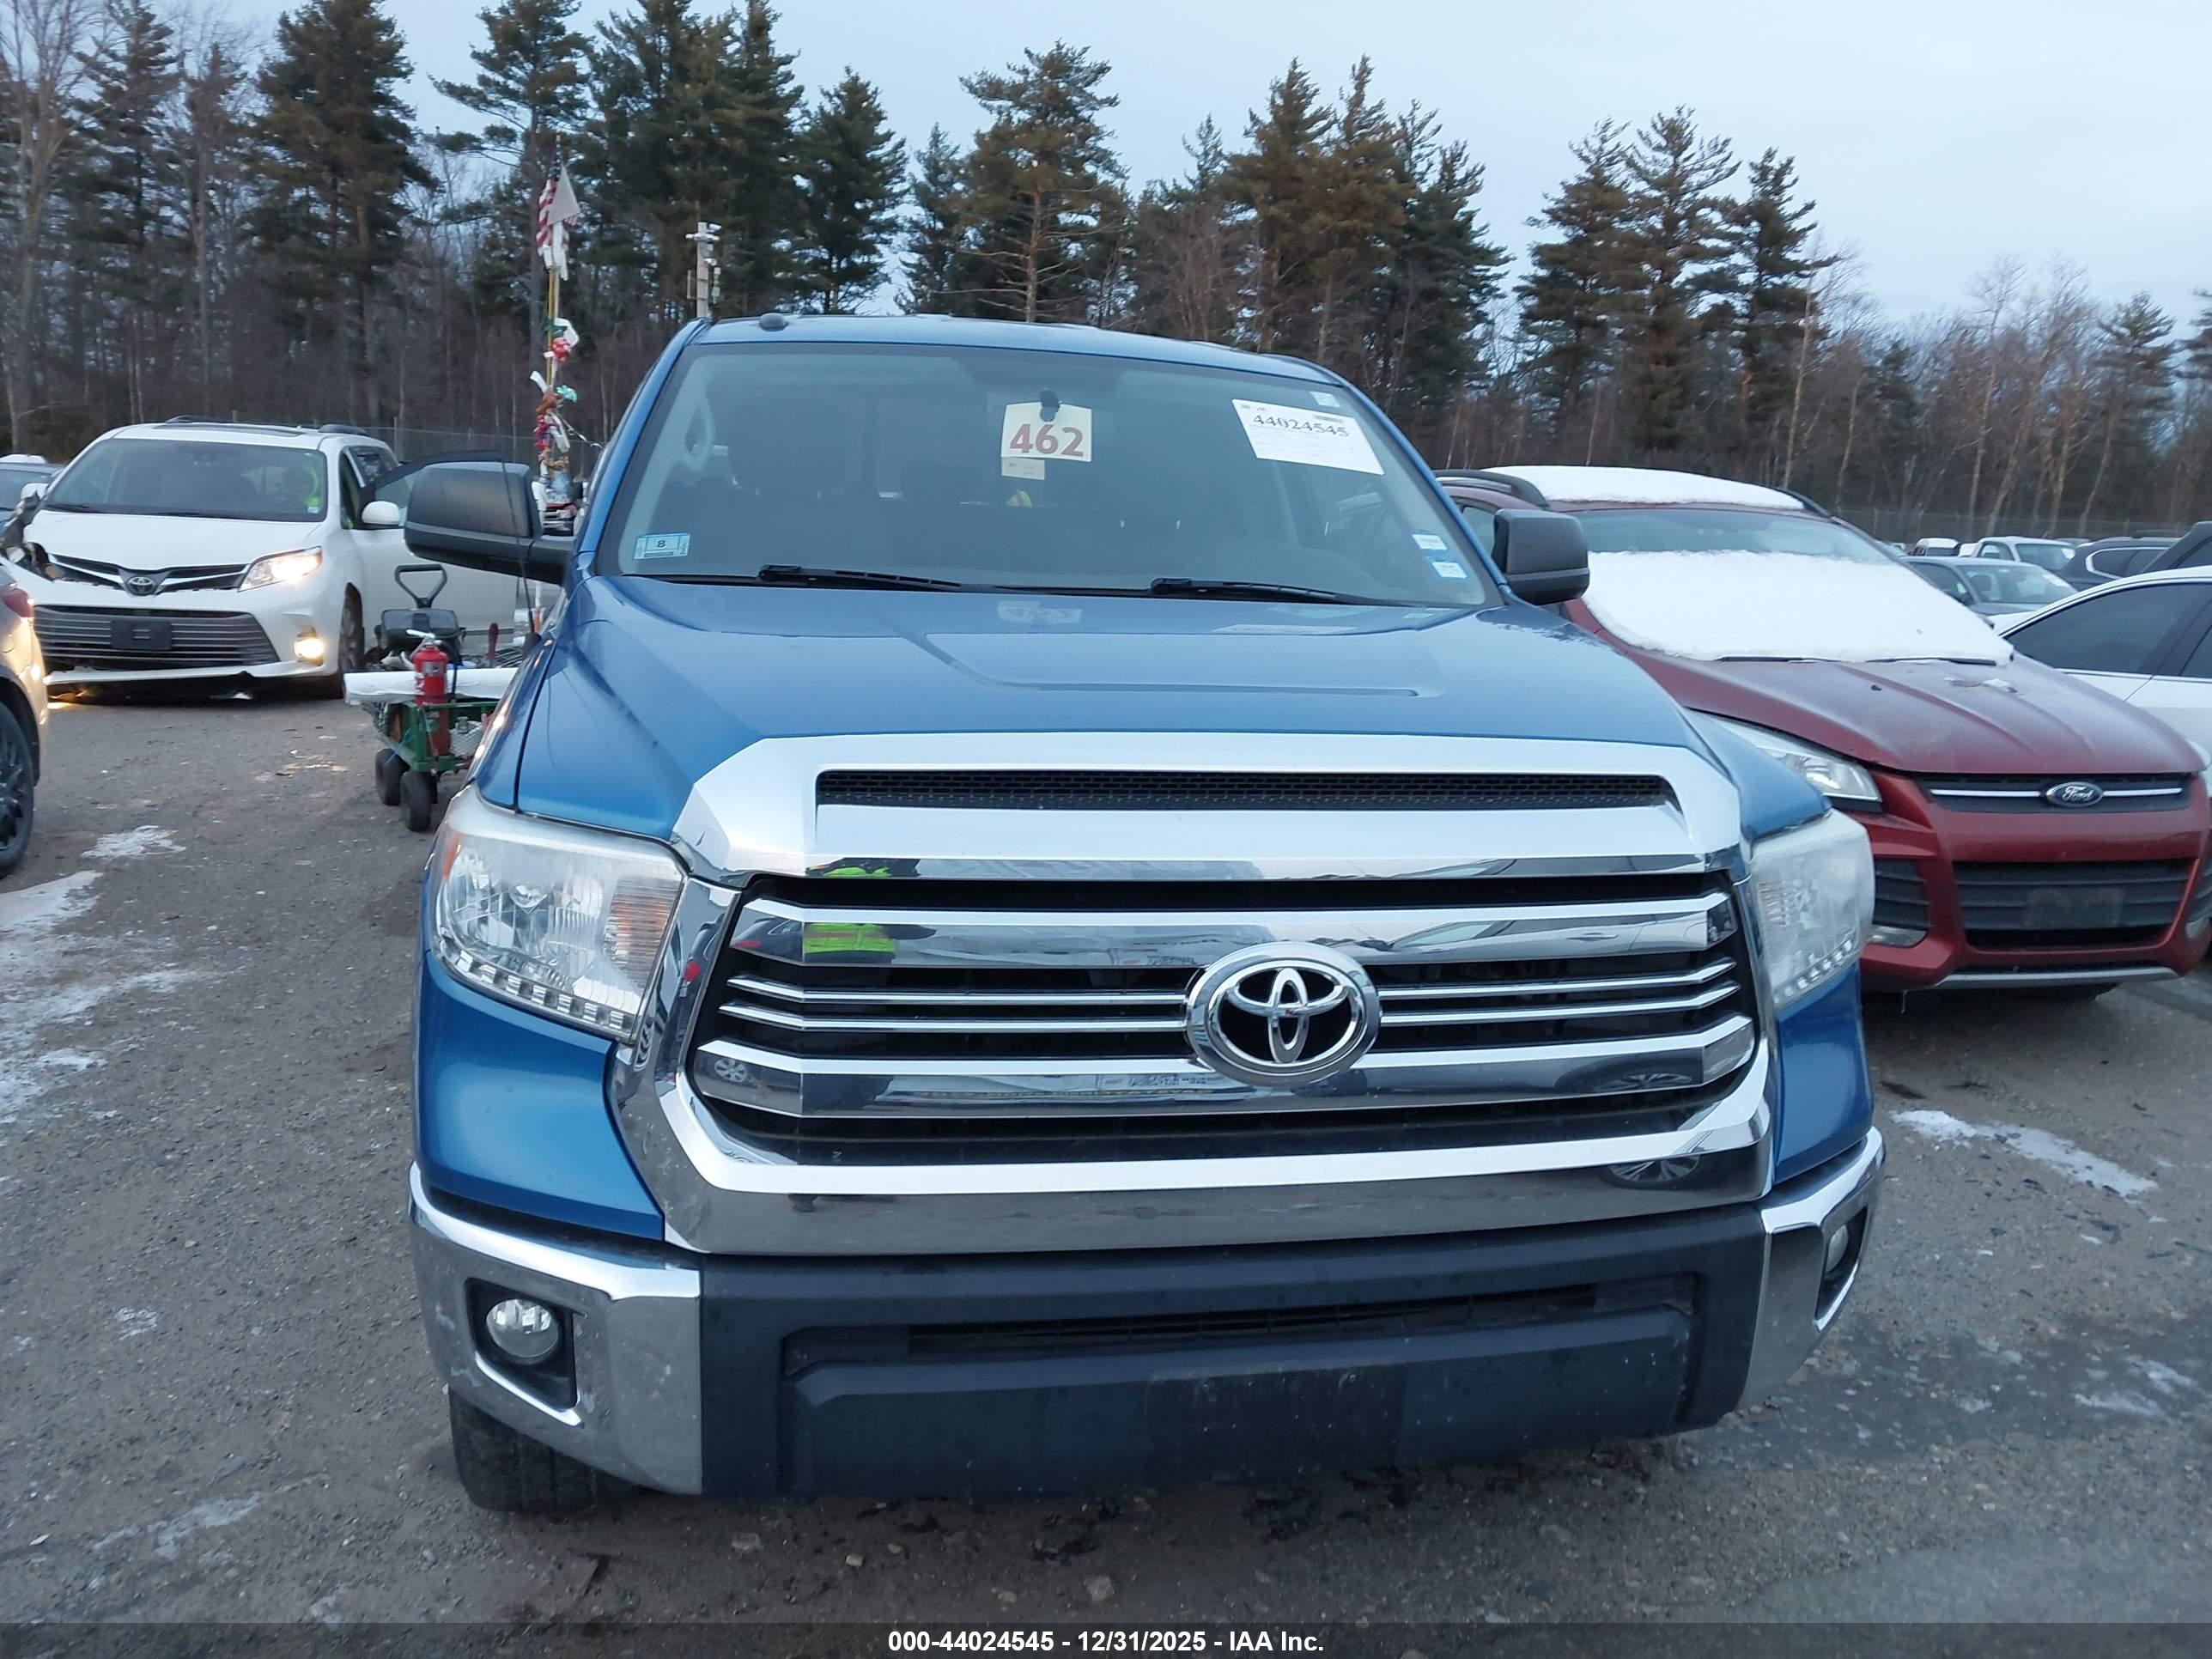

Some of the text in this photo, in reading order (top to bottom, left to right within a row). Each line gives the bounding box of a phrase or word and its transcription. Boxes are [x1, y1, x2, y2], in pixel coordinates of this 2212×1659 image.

[1253, 415, 1349, 436] 44024545
[1009, 422, 1085, 458] 462
[657, 539, 666, 548] 8
[2062, 786, 2094, 802] Ford
